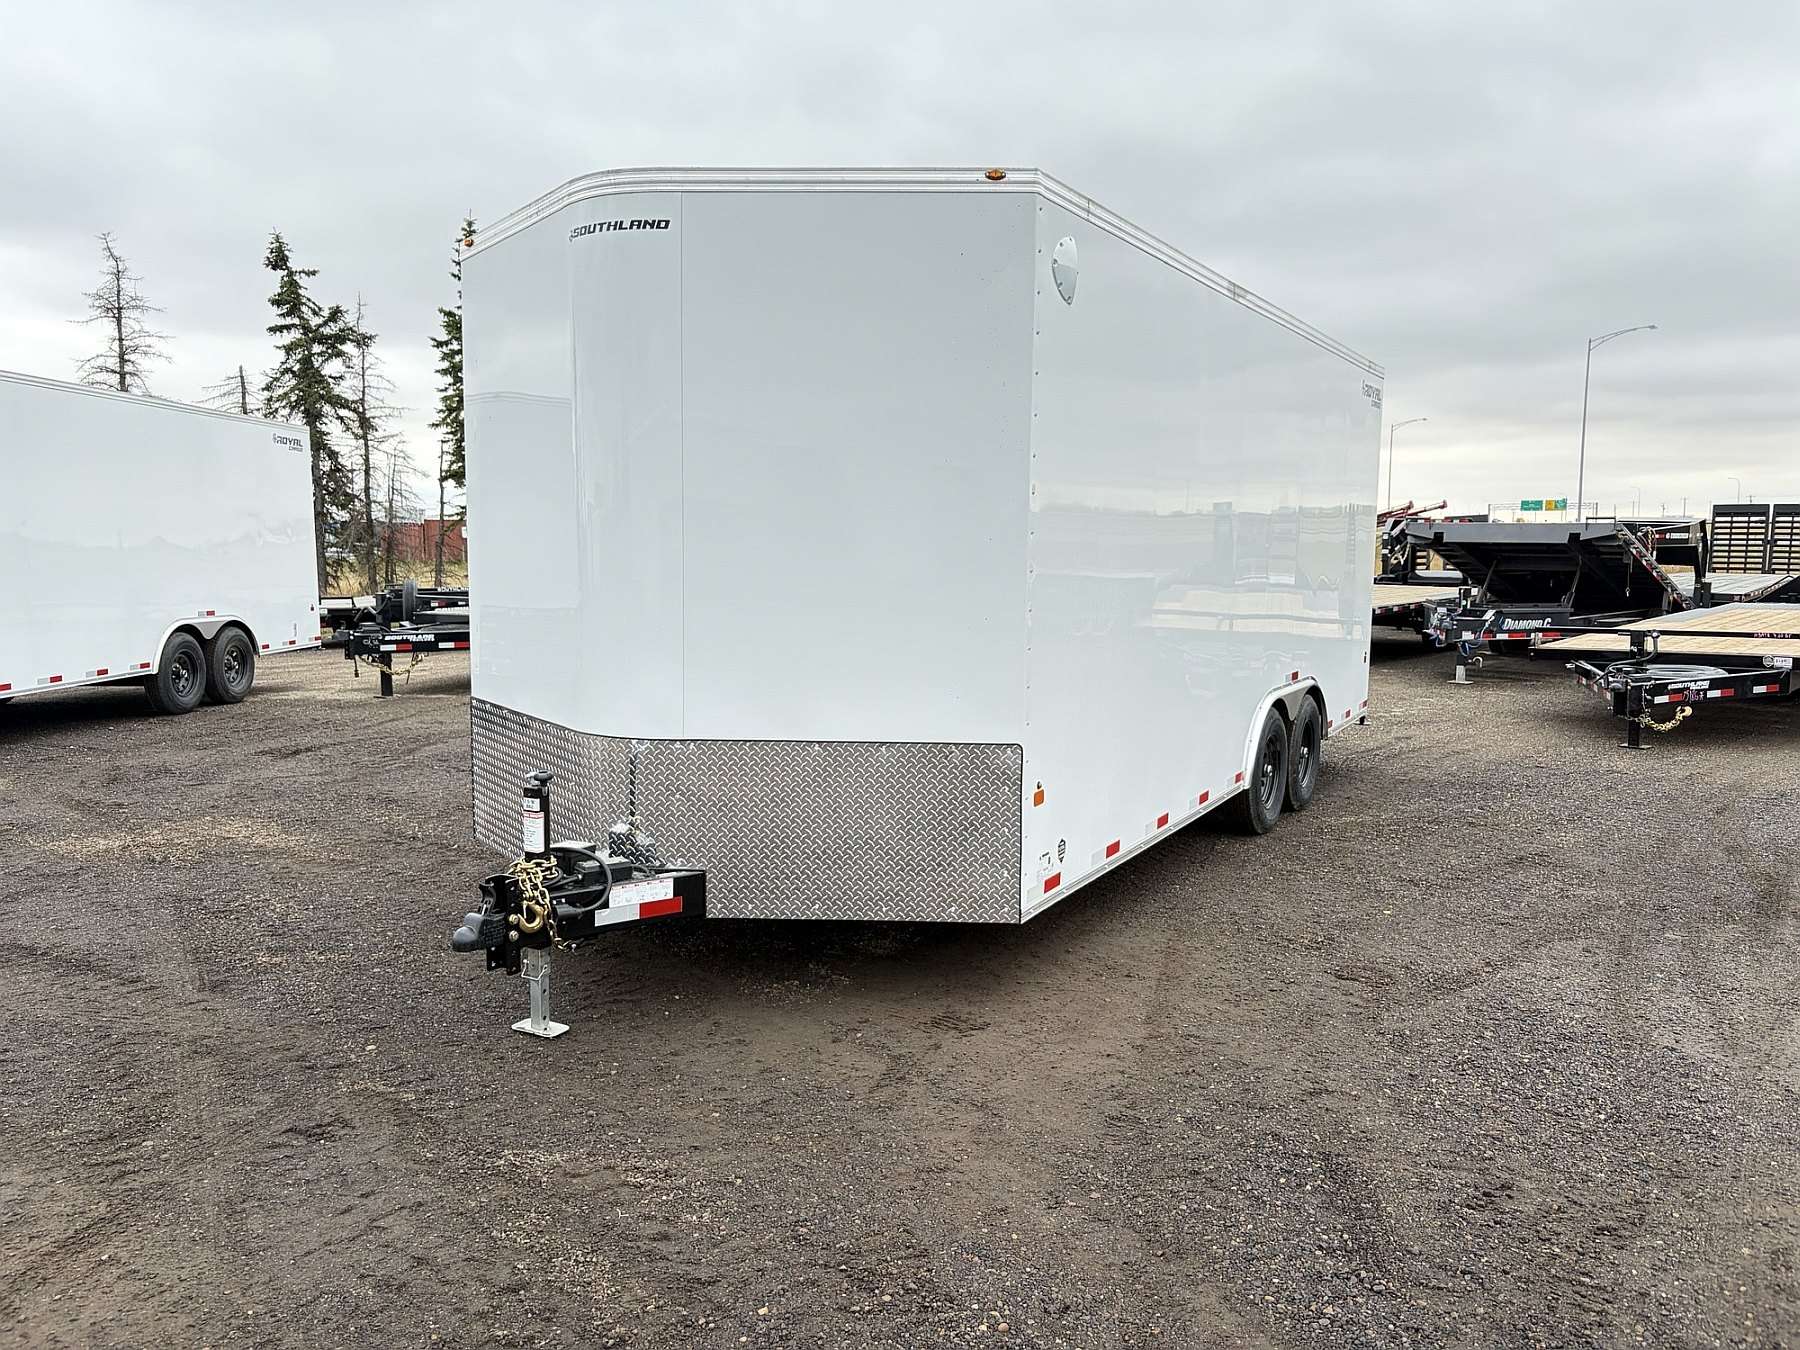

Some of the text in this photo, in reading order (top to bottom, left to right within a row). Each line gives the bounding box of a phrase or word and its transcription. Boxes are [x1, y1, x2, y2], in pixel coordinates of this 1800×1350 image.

[572, 219, 670, 239] SOUTHLAND
[276, 435, 303, 447] ROYAL
[1503, 617, 1552, 630] DIAMOND C
